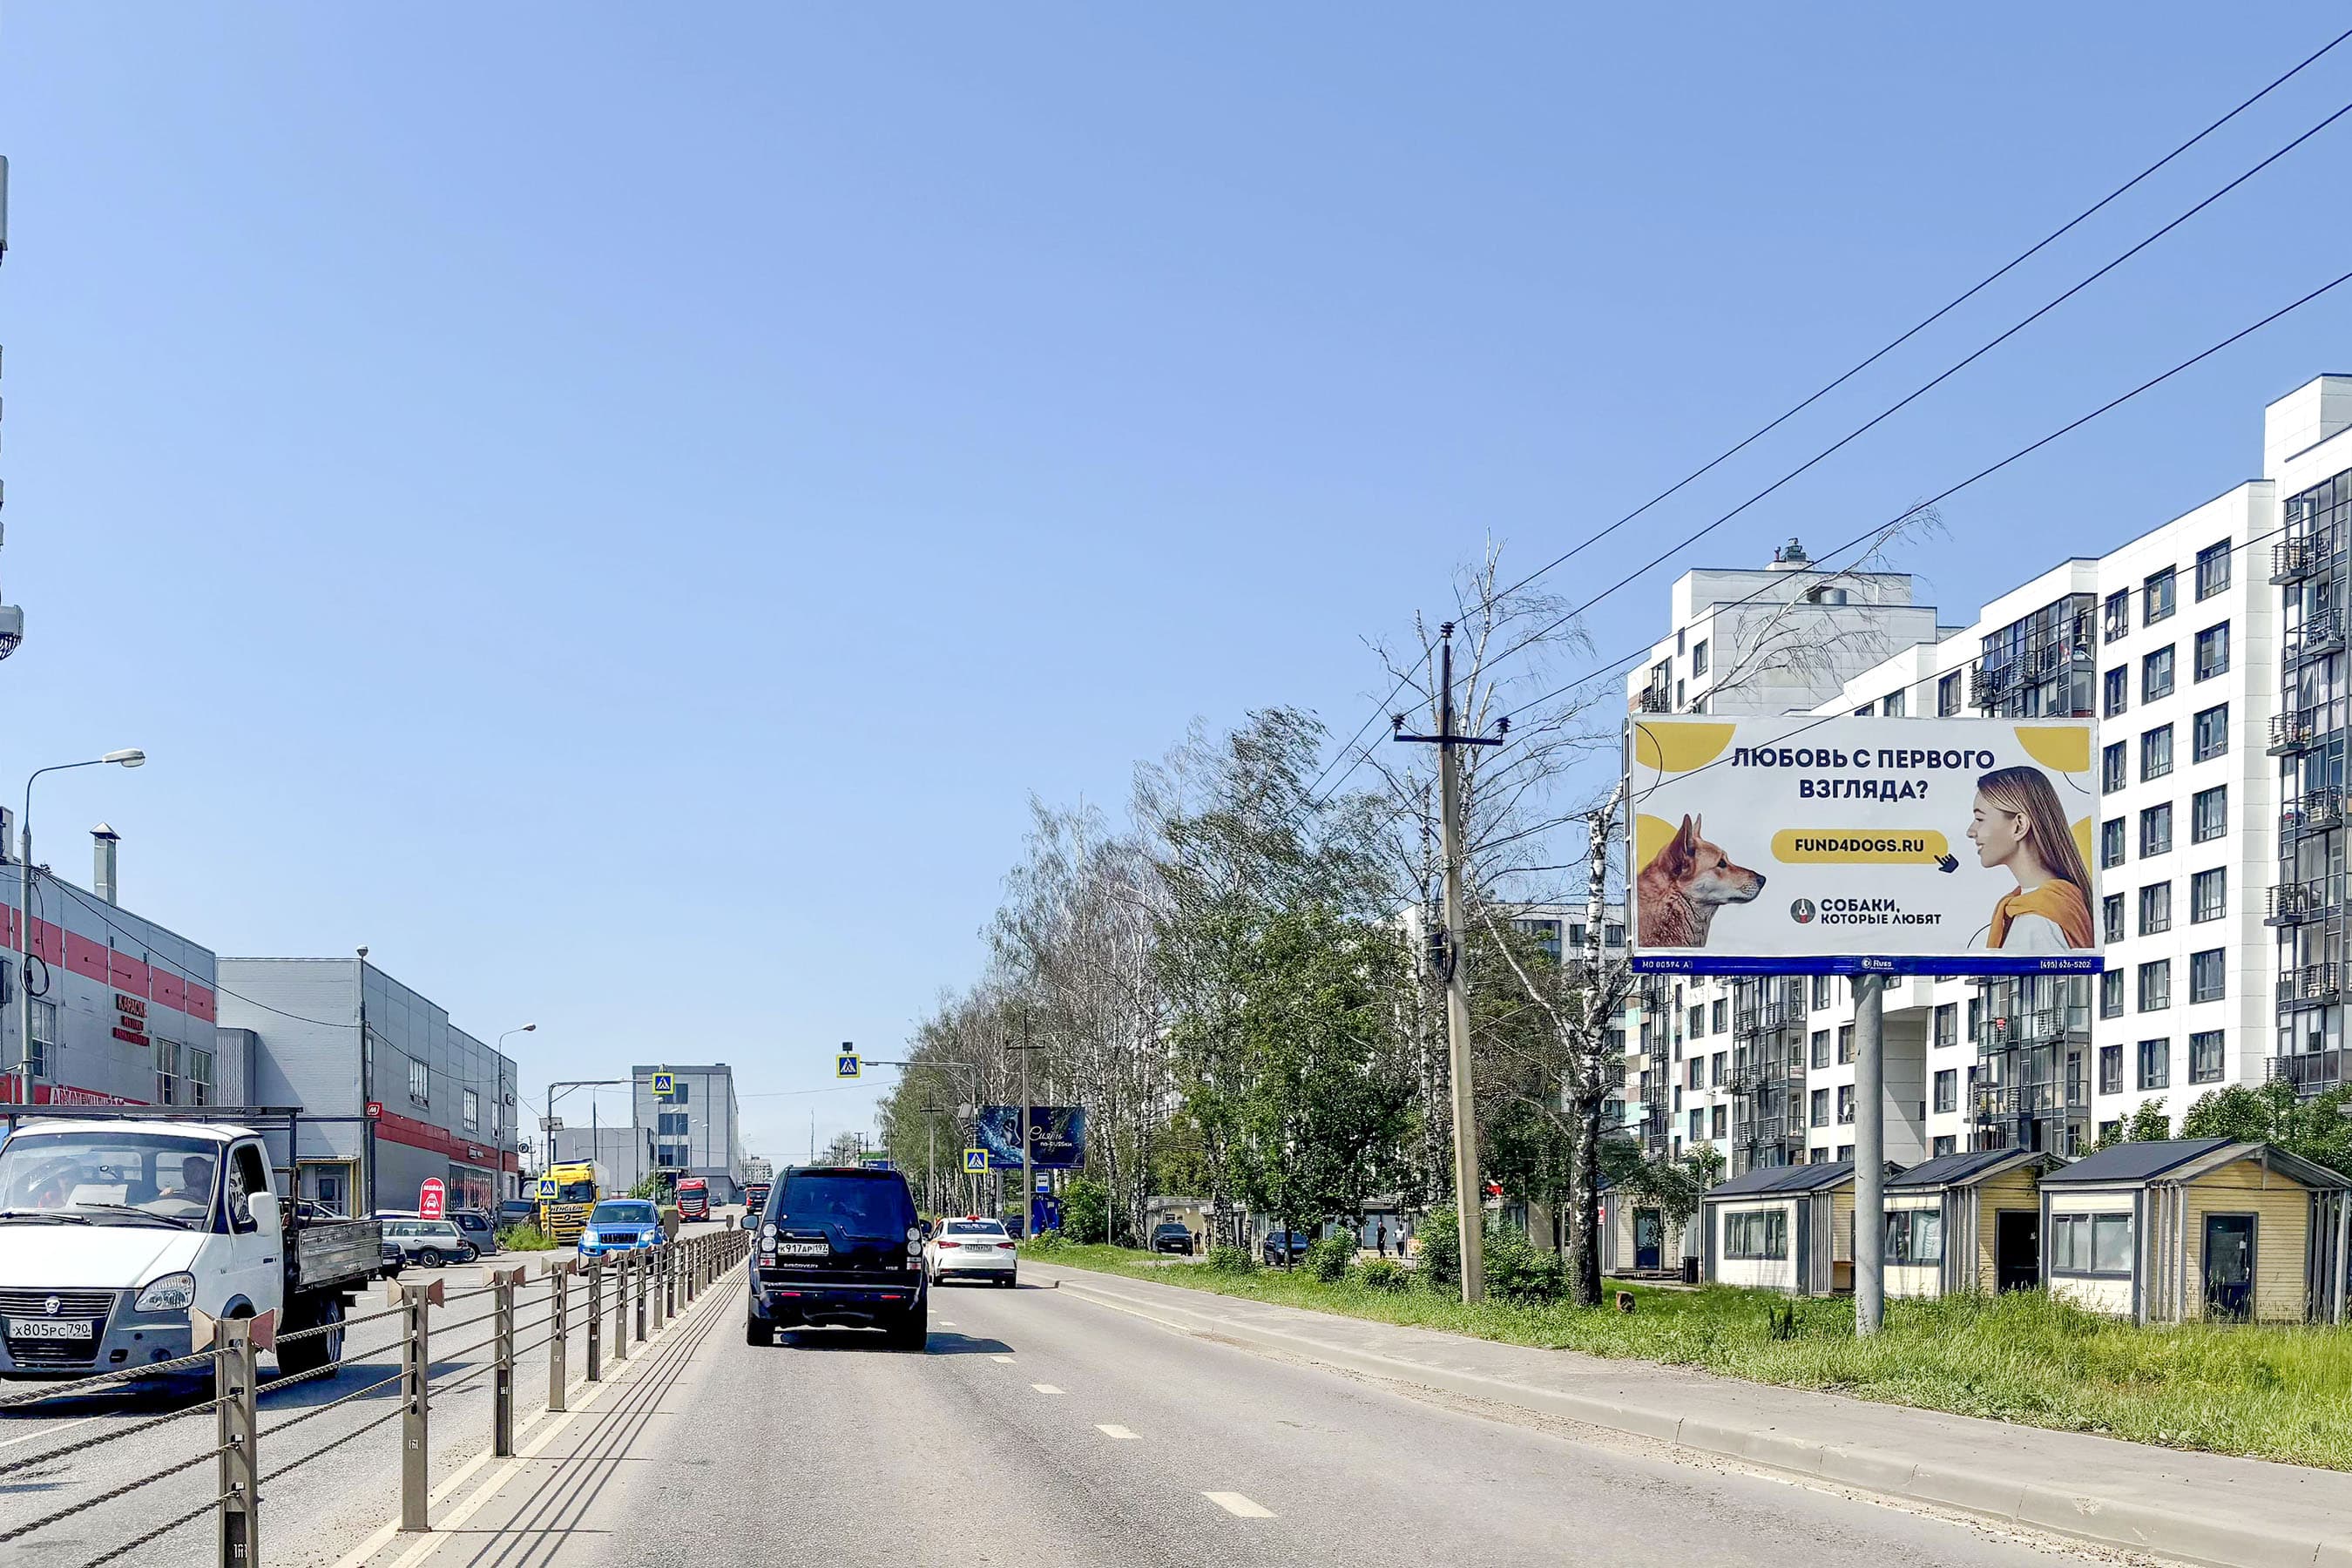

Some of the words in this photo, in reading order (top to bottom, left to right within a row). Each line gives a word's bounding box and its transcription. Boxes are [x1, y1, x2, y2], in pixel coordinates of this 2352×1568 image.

[1732, 747, 1848, 767] ЛЮБОВЬ
[1853, 749, 1870, 767] С
[1878, 749, 1995, 768] ПЕРВОГО
[1800, 779, 1928, 802] ВЗГЛЯДА?
[1794, 839, 1924, 852] FUND4DOGS.RU
[1821, 898, 1900, 913] СОБАКИ,
[1821, 914, 1888, 924] КОТОРЫЕ
[1892, 914, 1942, 924] ЛЮБЯТ
[15, 1324, 66, 1337] Х805РС
[69, 1324, 88, 1334] 790
